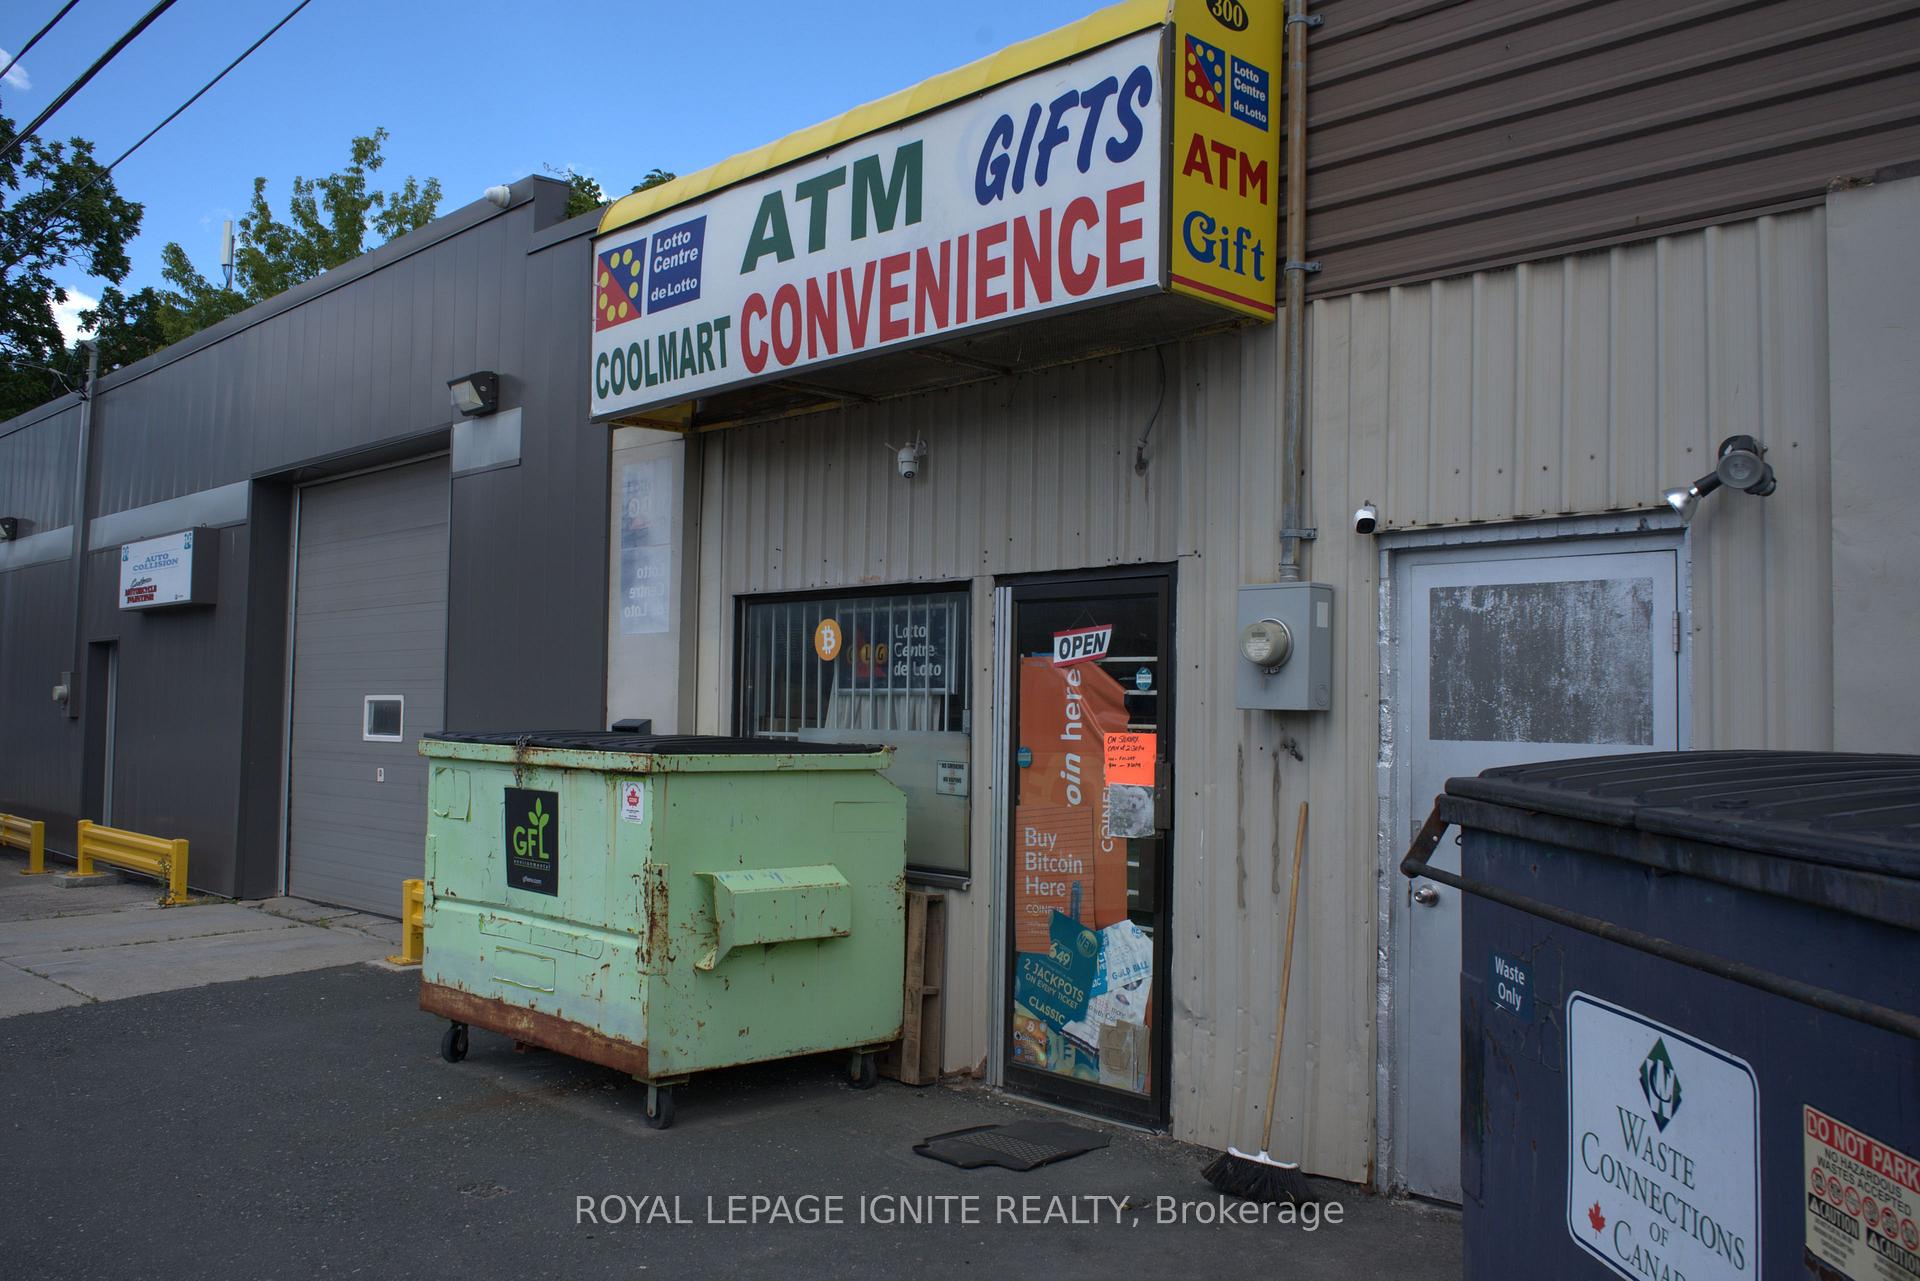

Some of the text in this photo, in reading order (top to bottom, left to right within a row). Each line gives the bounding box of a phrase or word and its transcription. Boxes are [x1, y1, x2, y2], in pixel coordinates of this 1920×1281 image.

[1212, 0, 1243, 28] 300
[1234, 62, 1260, 84] Lotto
[1233, 79, 1266, 102] Centre
[1233, 100, 1267, 123] de Lotto
[974, 64, 1153, 207] GIFTS
[1182, 133, 1268, 206] ATM
[740, 139, 924, 276] ATM
[656, 231, 691, 253] Lotto
[1183, 210, 1265, 282] Gift
[653, 248, 698, 273] Centre
[651, 277, 698, 301] de Lotto
[740, 180, 1146, 375] CONVENIENCE
[596, 315, 731, 400] COOLMART
[133, 557, 179, 571] COLLISION
[145, 552, 169, 563] AUTO
[895, 624, 926, 639] Lotto
[1059, 631, 1107, 660] OPEN
[894, 642, 936, 658] Centre
[894, 661, 908, 677] de
[1060, 668, 1082, 807] oin here
[513, 824, 550, 859] GFL
[1025, 827, 1057, 851] Buy
[1025, 852, 1083, 874] Bitcoin
[1025, 876, 1066, 897] Here
[1024, 958, 1031, 971] 2
[1033, 963, 1084, 1003] JACKPOTS
[1495, 956, 1525, 985] Waste
[1025, 973, 1036, 986] ON
[1036, 979, 1056, 997] EVERY
[1057, 991, 1079, 1010] TICKET
[1498, 982, 1521, 1011] Only
[1028, 995, 1066, 1026] CLASSIC
[1616, 1105, 1696, 1191] WASTE
[1807, 1112, 1920, 1193] DO NOT PARK
[1817, 1155, 1912, 1216] WASTES ACCEPTED
[1824, 1148, 1903, 1198] NO HAZARDOUS
[1581, 1131, 1745, 1271] CONNECTIONS
[1649, 1221, 1669, 1248] OF
[1820, 1202, 1859, 1238] CAUTION
